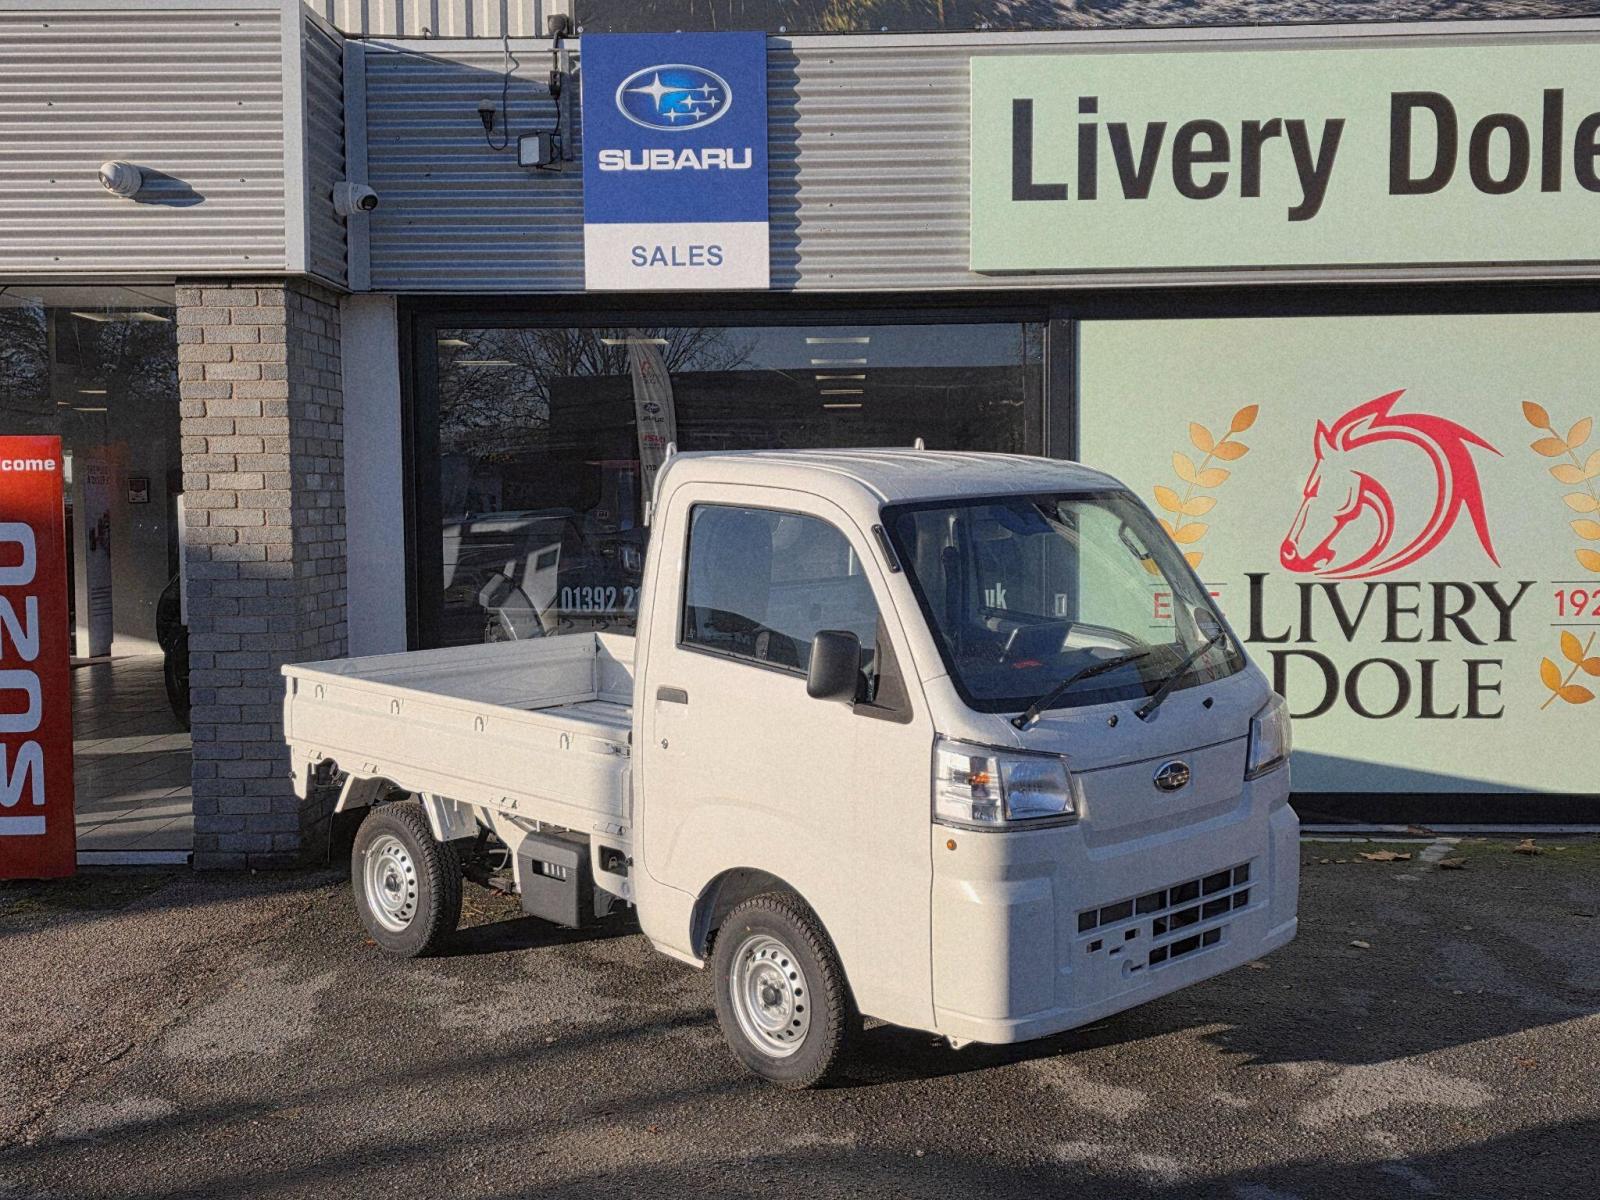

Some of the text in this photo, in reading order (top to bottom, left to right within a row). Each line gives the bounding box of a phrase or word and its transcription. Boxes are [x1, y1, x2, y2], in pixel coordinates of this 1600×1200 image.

[598, 147, 753, 172] SUBARU
[1011, 96, 1346, 222] Livery
[631, 244, 724, 267] SALES
[0, 458, 56, 472] come
[561, 586, 617, 612] 01392
[1243, 571, 1538, 646] LIVERY
[0, 522, 46, 836] ISUZU
[1266, 649, 1506, 720] DOLE
